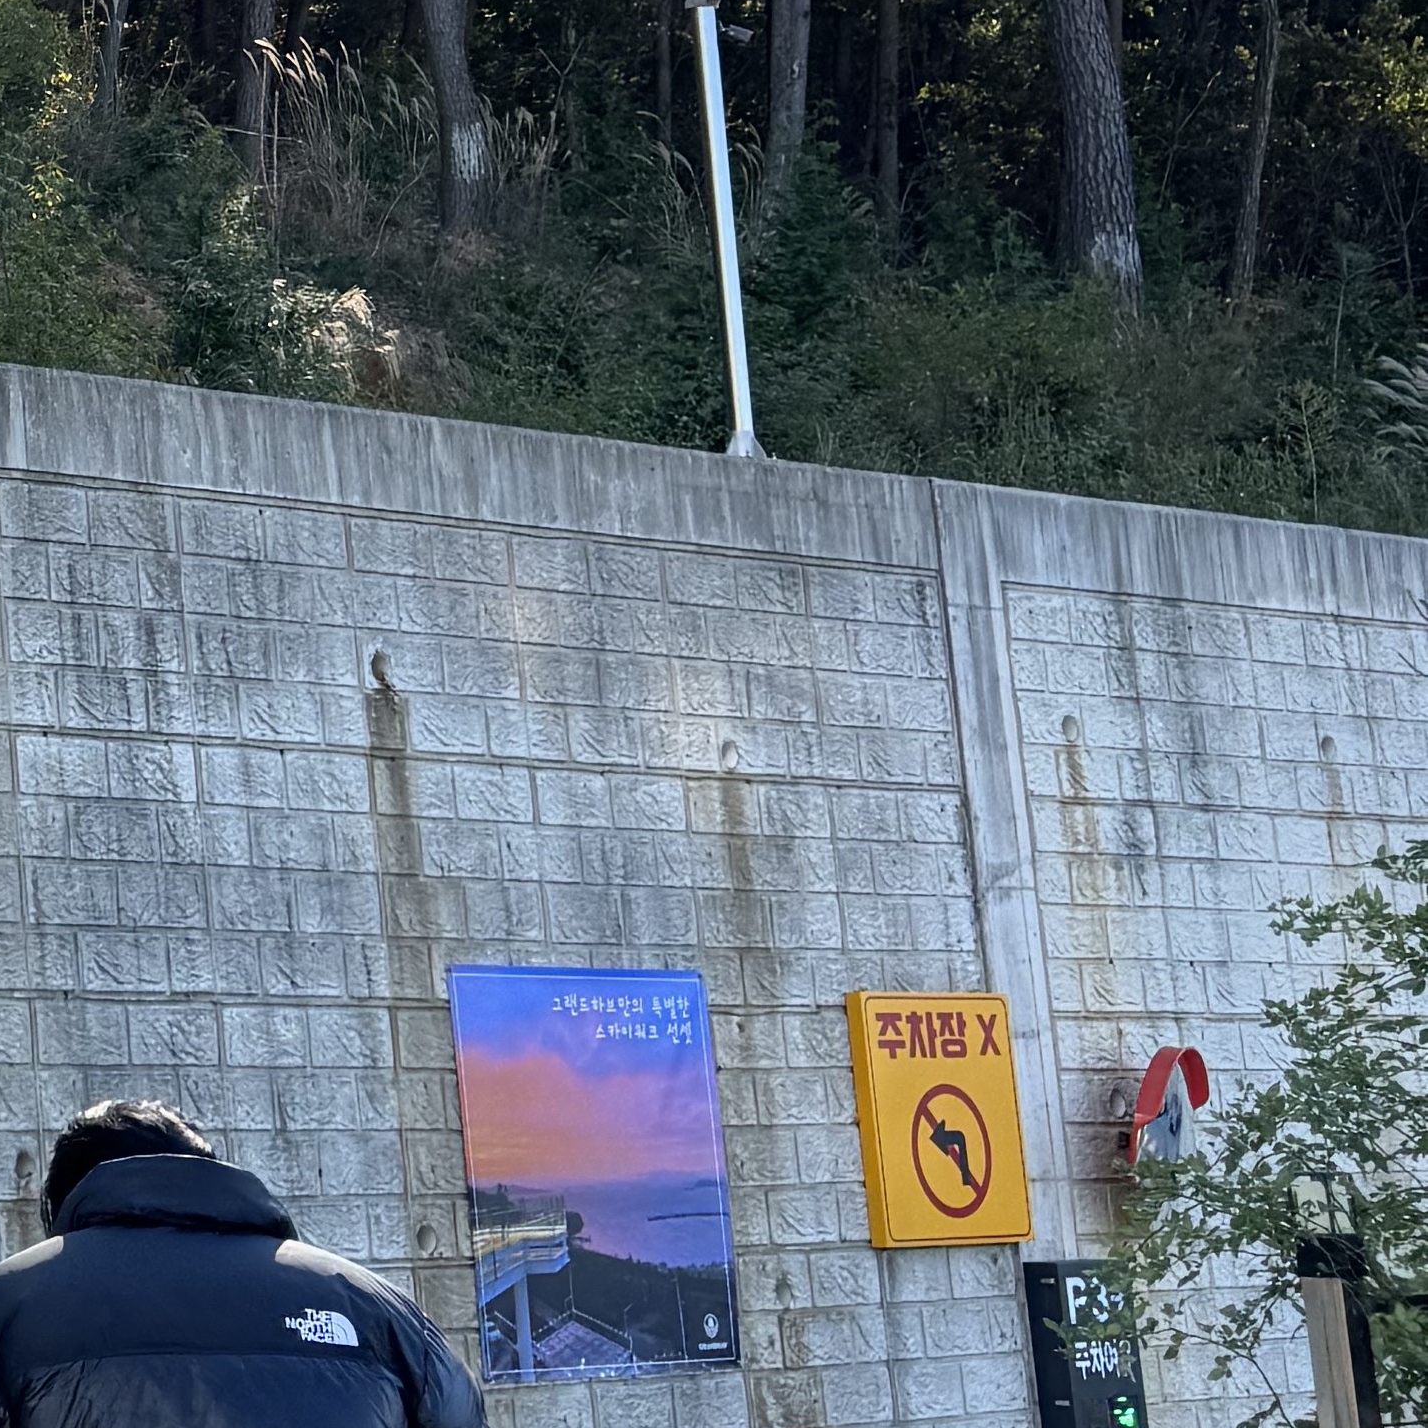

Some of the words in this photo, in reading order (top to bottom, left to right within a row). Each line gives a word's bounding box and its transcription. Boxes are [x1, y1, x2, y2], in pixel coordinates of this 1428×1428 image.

[651, 995, 690, 1020] 특별한
[875, 1011, 968, 1059] 주차장
[975, 1013, 1002, 1056] X
[305, 1308, 332, 1322] THE
[284, 1316, 333, 1334] NORTH
[300, 1330, 334, 1344] FACE
